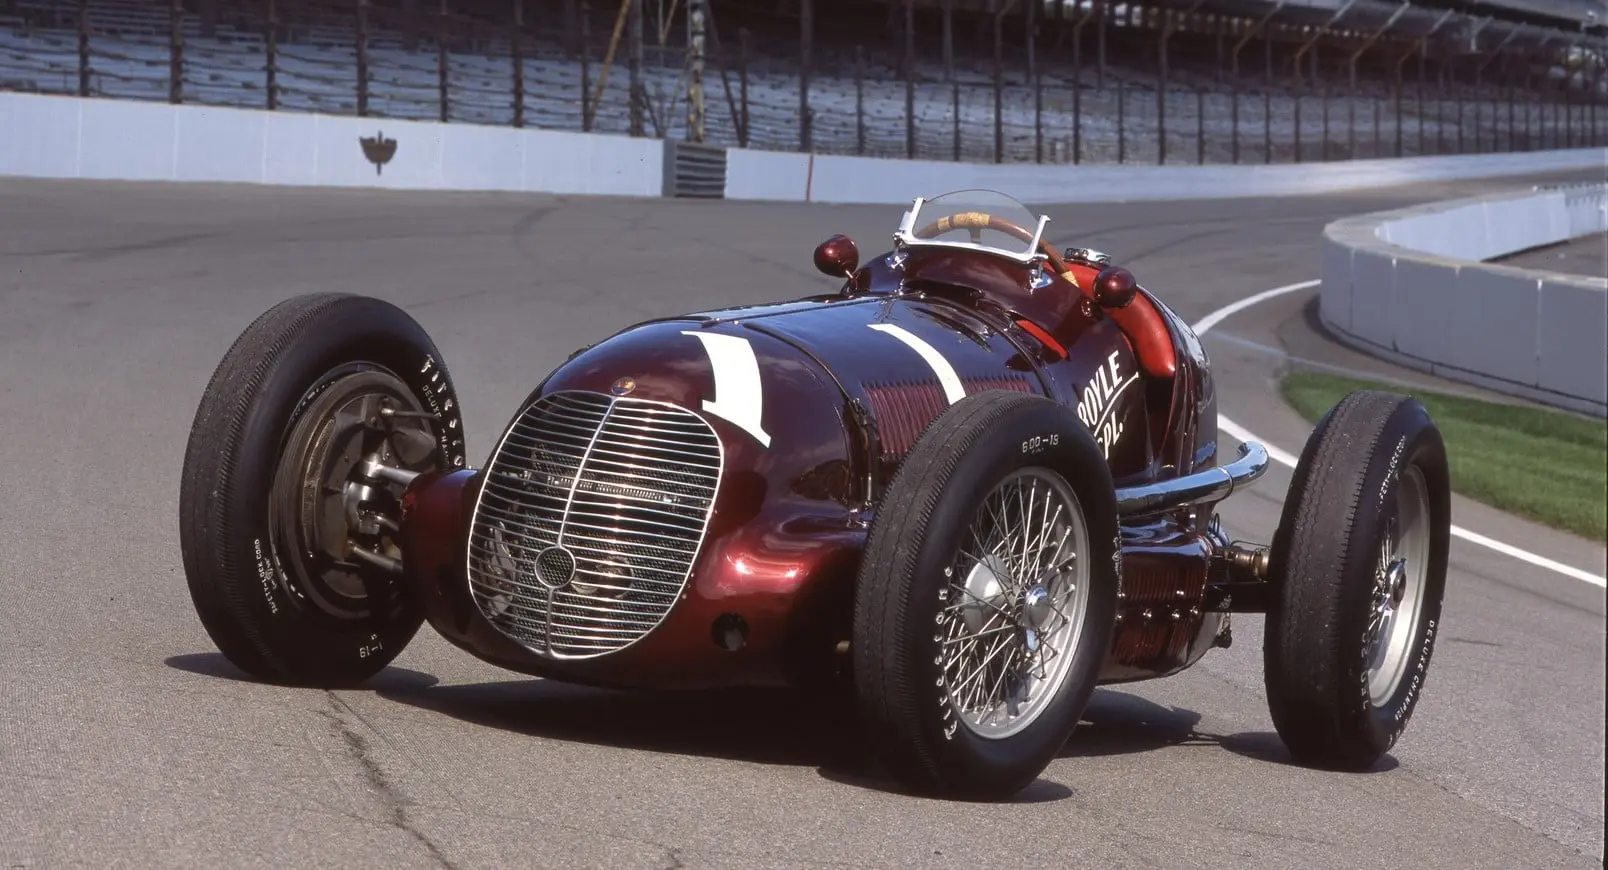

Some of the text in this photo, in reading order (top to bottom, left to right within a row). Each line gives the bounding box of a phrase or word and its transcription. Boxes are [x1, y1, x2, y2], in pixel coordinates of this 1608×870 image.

[680, 330, 772, 448] 1
[933, 566, 957, 741] Firestone
[1417, 619, 1436, 672] DELUXE
